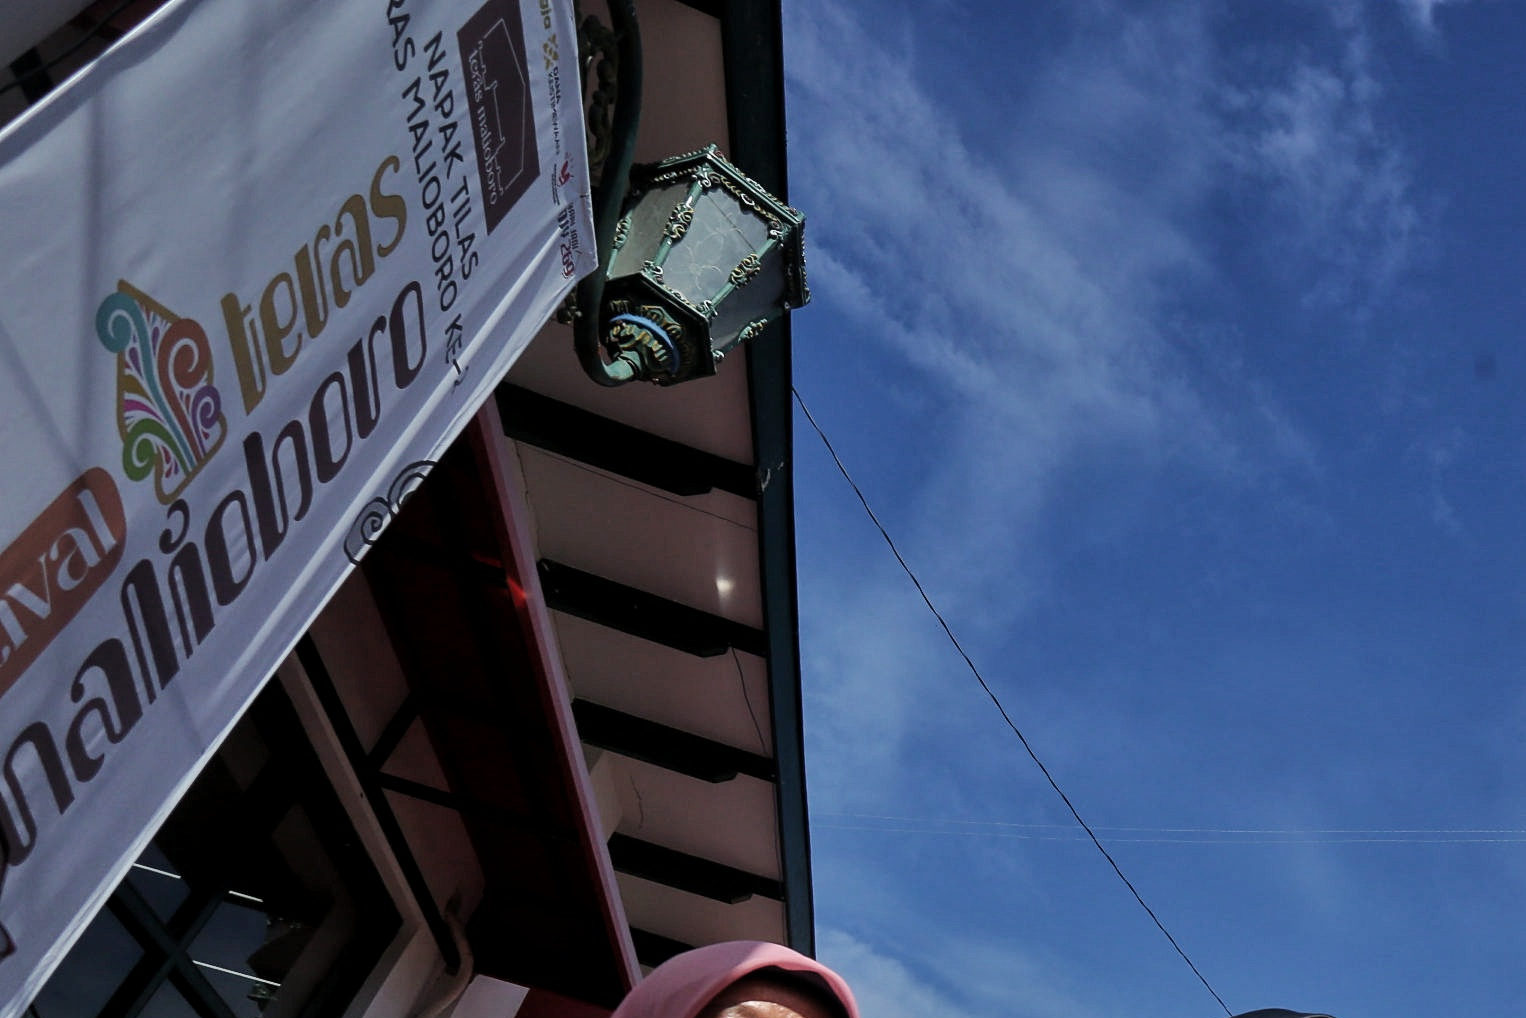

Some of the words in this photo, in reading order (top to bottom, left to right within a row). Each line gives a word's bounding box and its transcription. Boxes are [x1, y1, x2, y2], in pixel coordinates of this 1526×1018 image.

[402, 76, 459, 312] MALIOBORO
[423, 30, 465, 180] NAPAK
[449, 176, 479, 281] TILAS
[220, 153, 408, 417] teras
